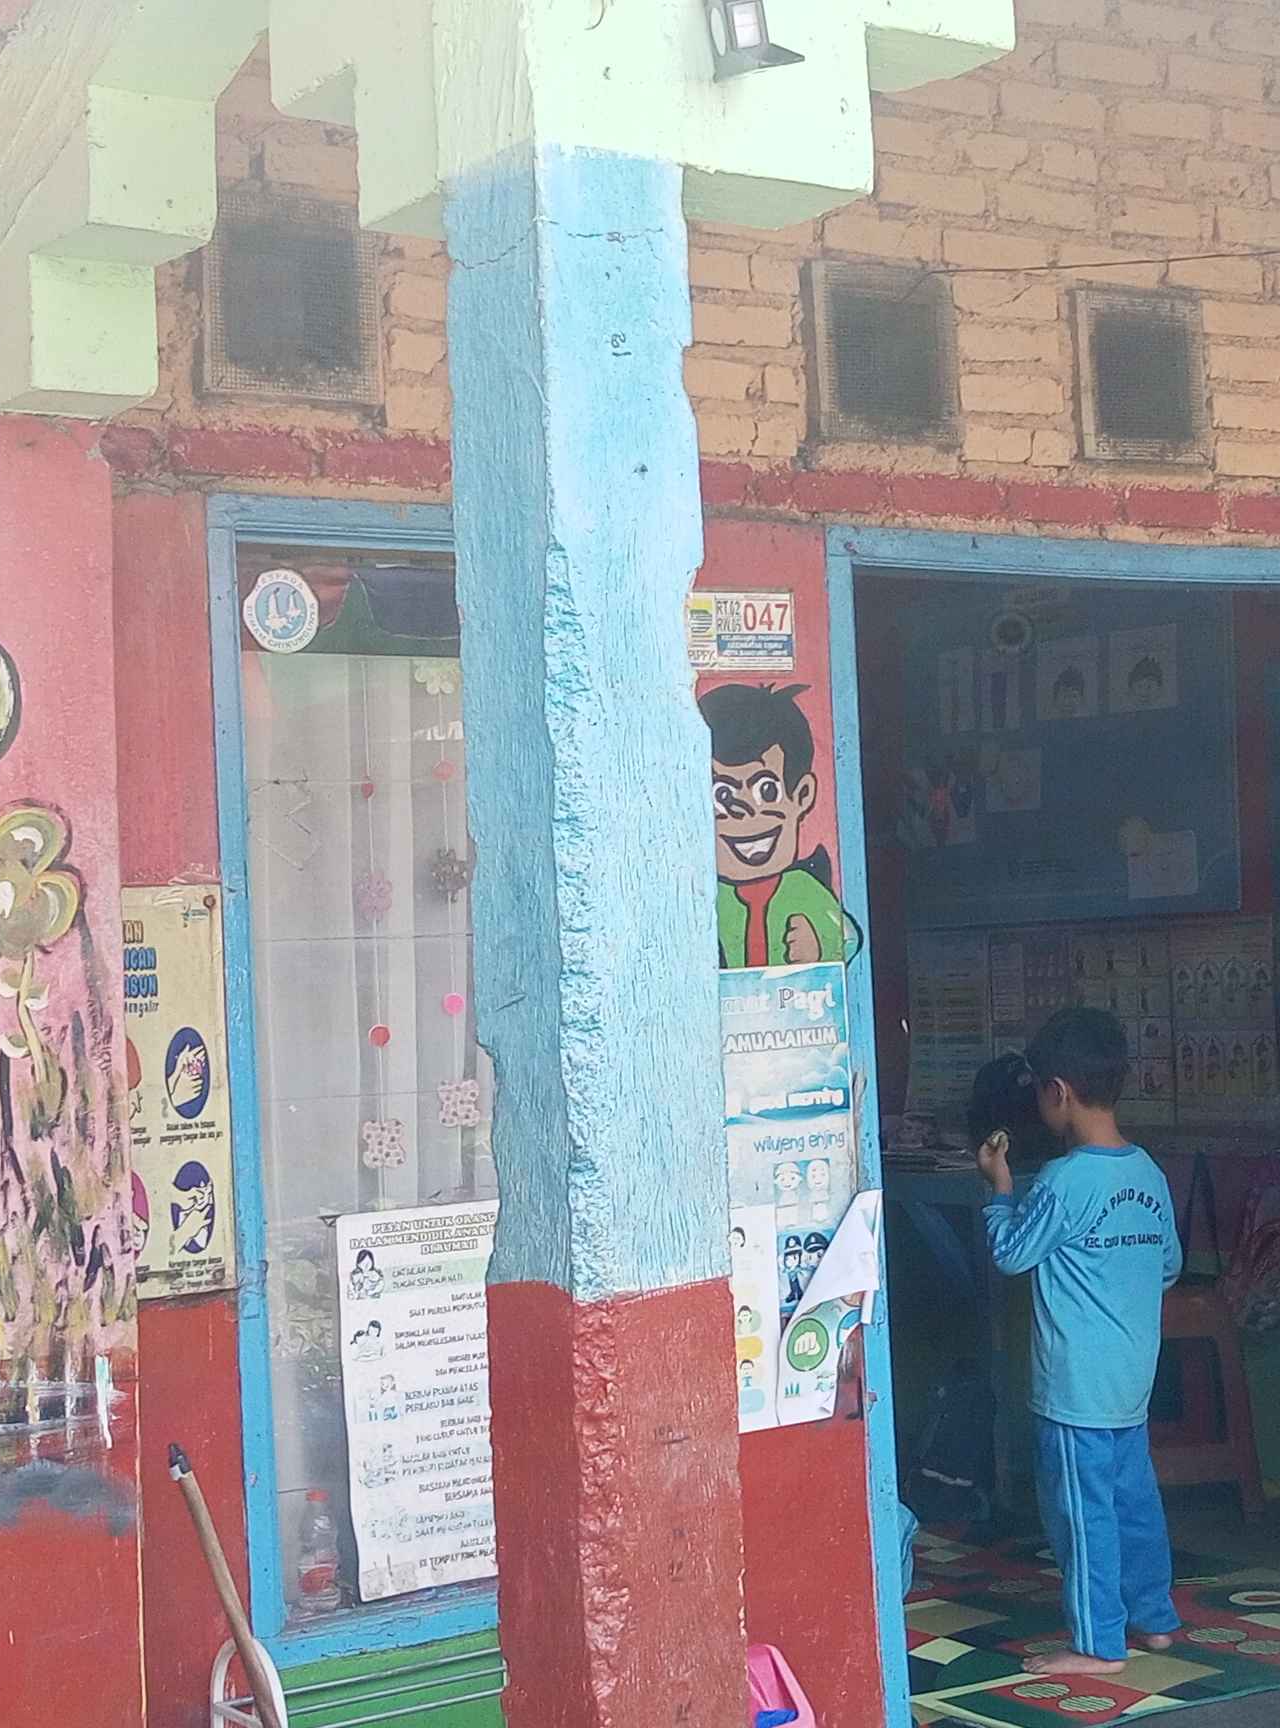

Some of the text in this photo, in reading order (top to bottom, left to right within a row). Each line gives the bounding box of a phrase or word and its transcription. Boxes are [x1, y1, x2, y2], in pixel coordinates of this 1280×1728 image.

[743, 602, 789, 631] 047
[778, 982, 837, 1021] Pagi
[753, 1134, 806, 1154] wilujeng
[1110, 1188, 1135, 1210] PAUD
